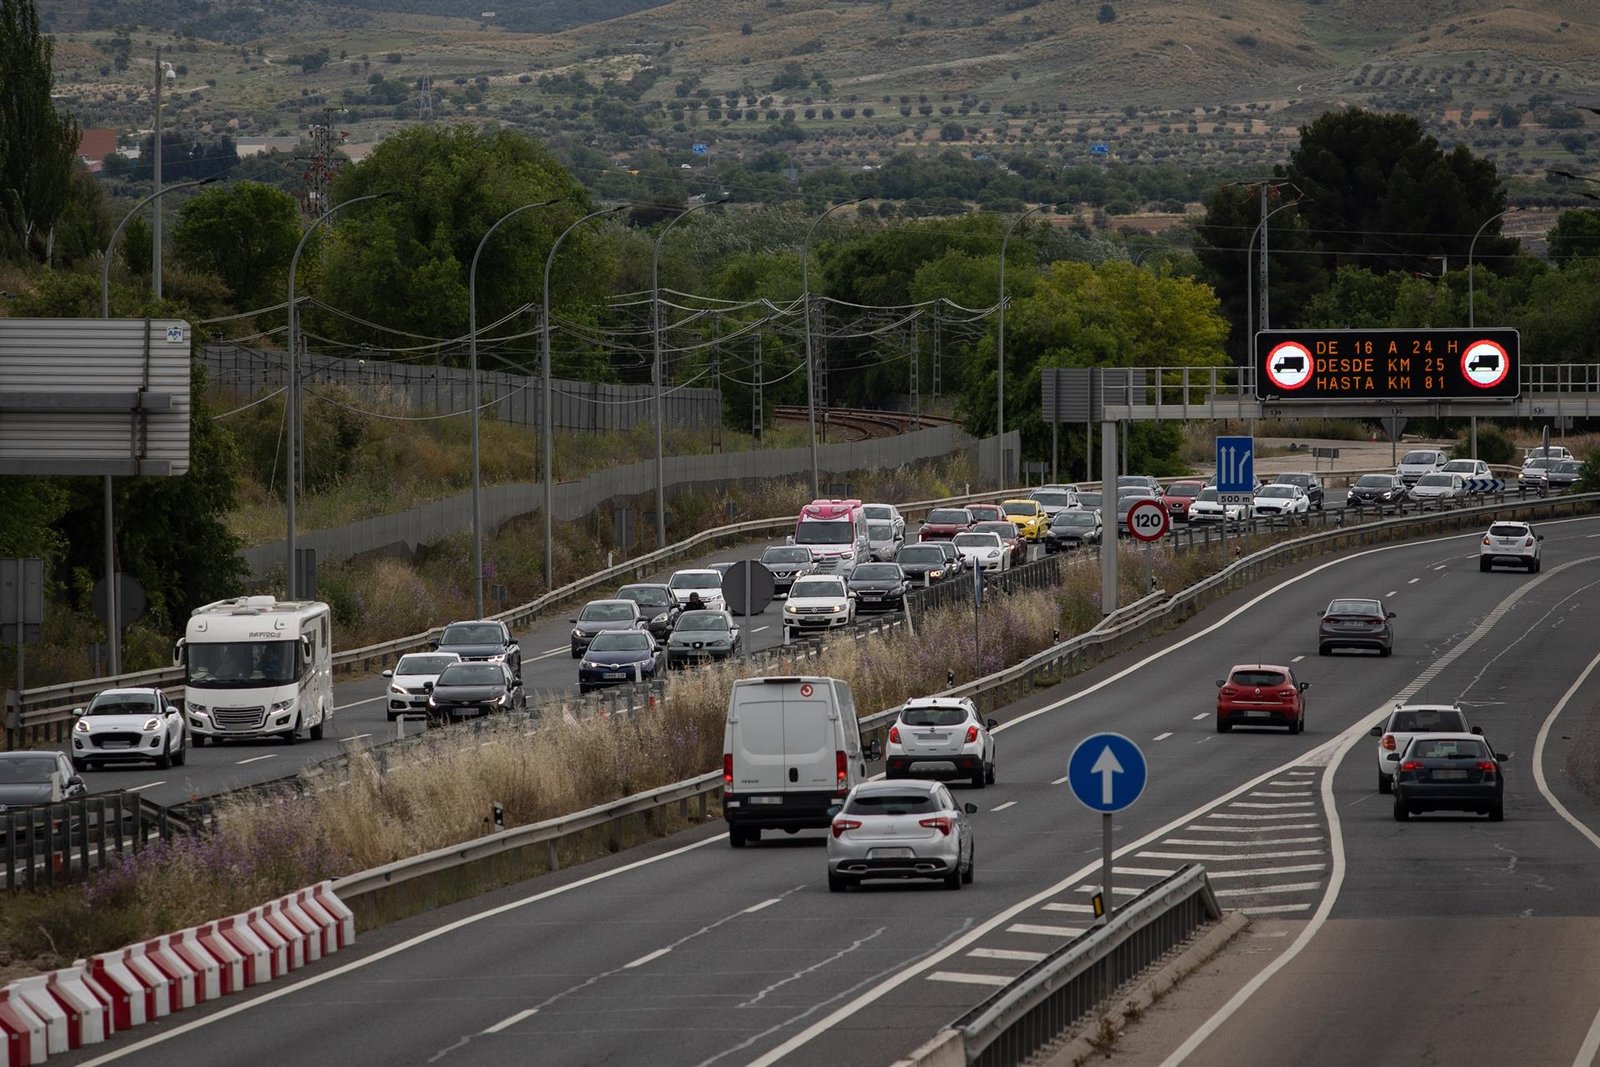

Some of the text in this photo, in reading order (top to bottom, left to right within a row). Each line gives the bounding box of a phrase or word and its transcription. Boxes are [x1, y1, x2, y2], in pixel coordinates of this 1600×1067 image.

[1317, 341, 1458, 354] DE 16 A 24 H
[1317, 358, 1444, 372] DESDE KM 25
[1317, 377, 1444, 390] HASTA KM 81
[1221, 495, 1240, 503] 500
[1135, 513, 1161, 527] 120
